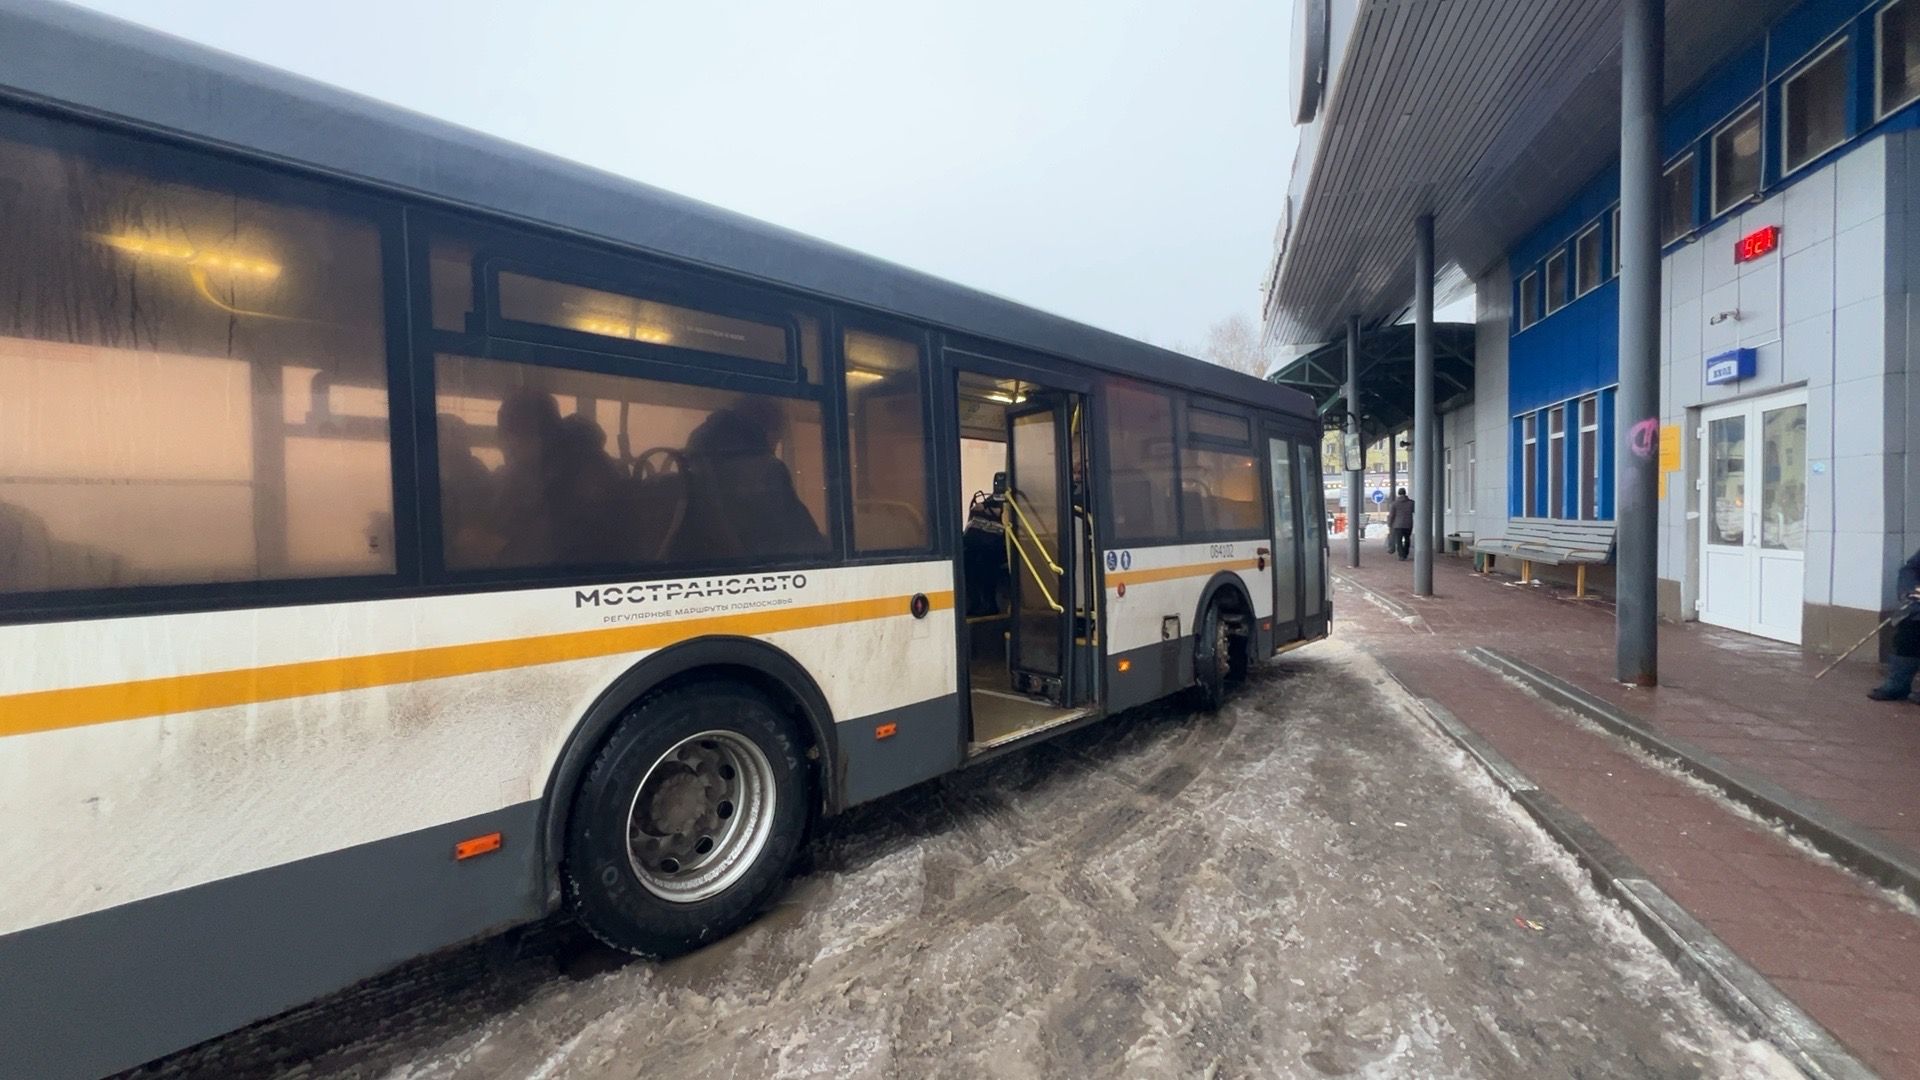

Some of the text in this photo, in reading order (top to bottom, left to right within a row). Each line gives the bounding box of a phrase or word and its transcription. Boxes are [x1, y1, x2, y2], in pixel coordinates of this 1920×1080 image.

[575, 574, 806, 608] МОСТРАНСАВТО
[603, 598, 793, 623] РЕГУЛЯРНЫЕ МАРШРУТЫ ПОДМОСКОВЬЯ
